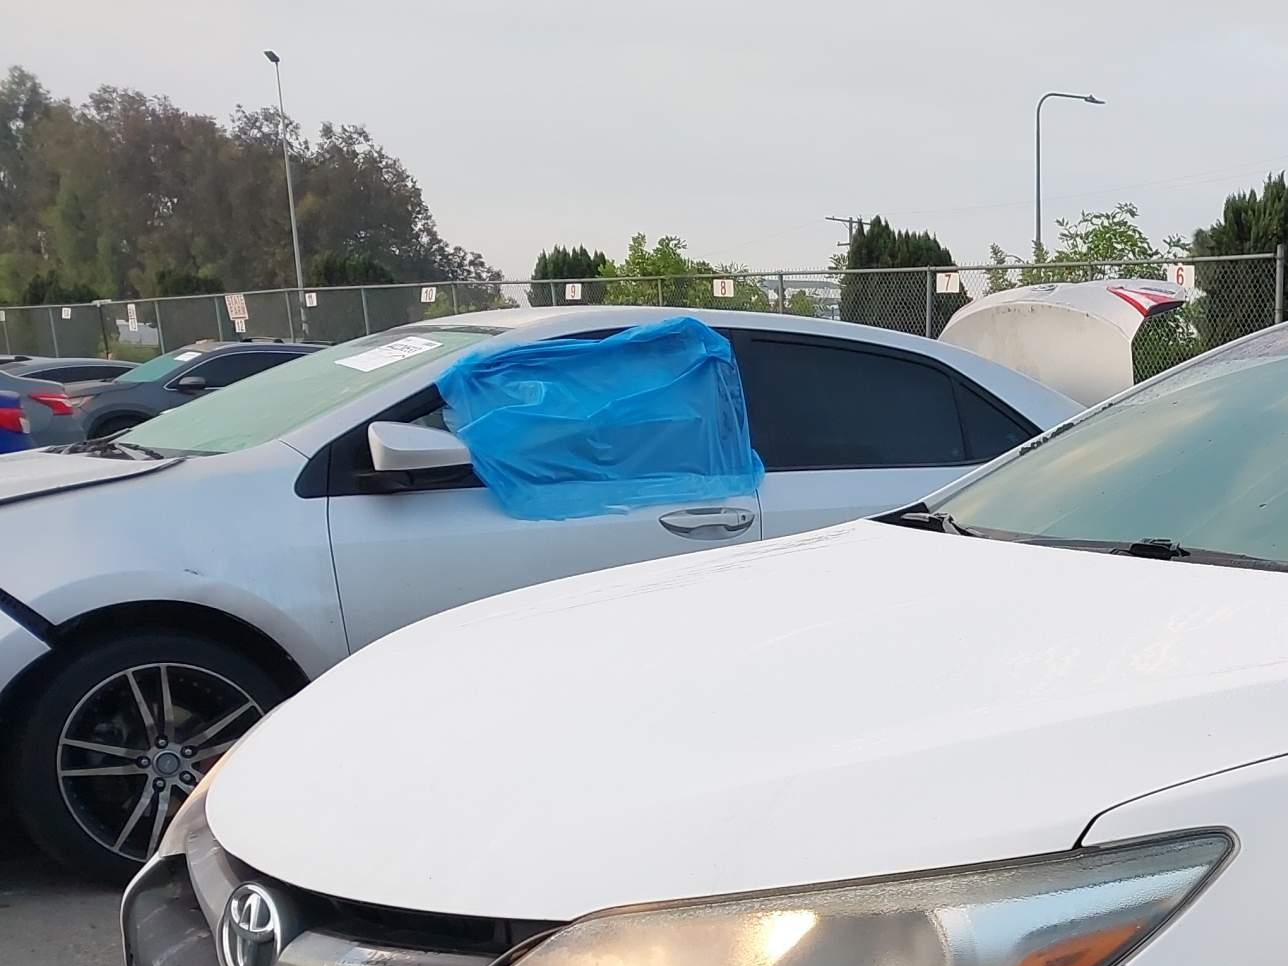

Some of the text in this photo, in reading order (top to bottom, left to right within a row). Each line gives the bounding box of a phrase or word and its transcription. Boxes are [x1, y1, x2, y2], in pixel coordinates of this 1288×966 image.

[944, 274, 952, 291] 7
[1176, 266, 1185, 286] 6
[425, 288, 433, 301] 10
[570, 285, 576, 298] 9
[720, 281, 727, 295] 8
